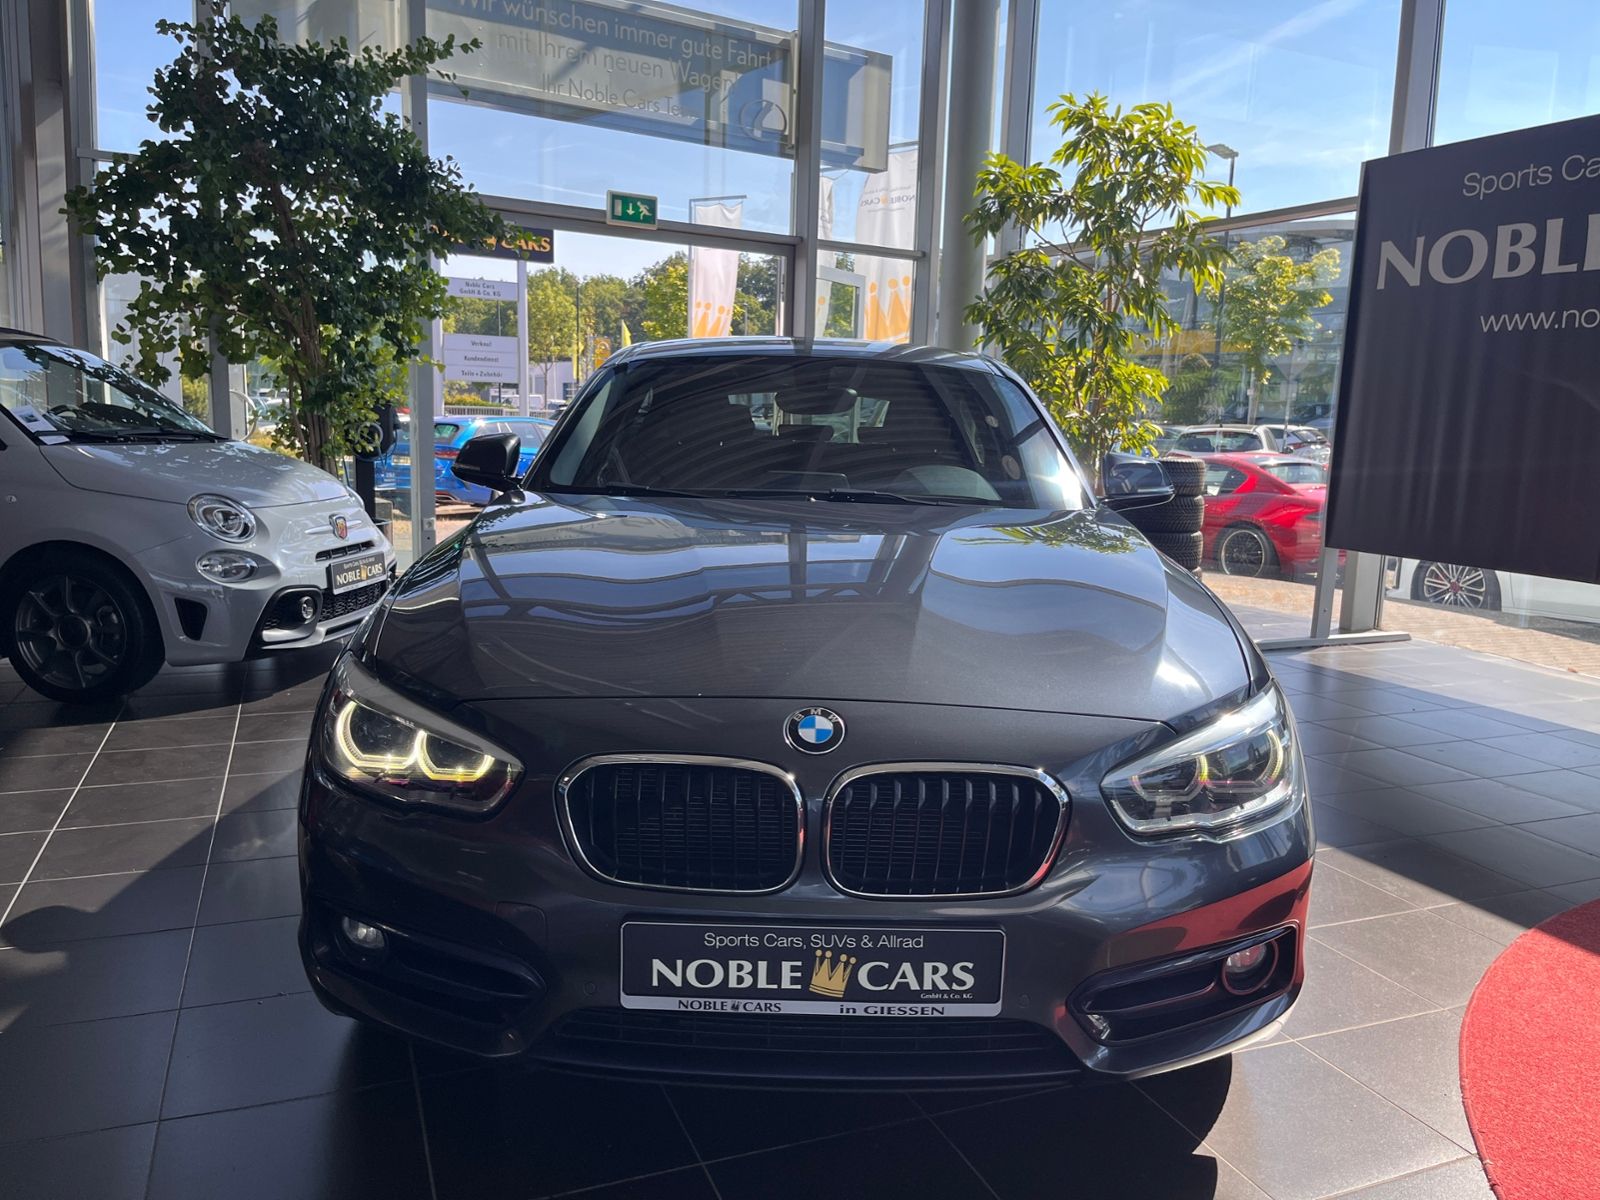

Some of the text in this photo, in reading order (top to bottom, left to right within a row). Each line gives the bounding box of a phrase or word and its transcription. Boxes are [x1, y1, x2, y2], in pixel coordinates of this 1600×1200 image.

[503, 0, 609, 36] wünschen
[615, 17, 677, 49] immer
[681, 38, 722, 61] gute
[496, 31, 530, 53] mit
[538, 32, 598, 66] Ihrem
[603, 53, 664, 80] neuen
[542, 73, 564, 94] Ihr
[568, 77, 618, 105] Noble
[623, 88, 660, 112] Cars
[1462, 162, 1553, 200] Sports
[1479, 307, 1600, 333] www.no
[337, 570, 361, 586] NOBLE
[367, 563, 383, 577] CARS
[792, 707, 839, 723] BMW
[704, 932, 924, 950] Sports Cars, SUVs & Allrad
[651, 958, 976, 992] NOBLE CARS
[677, 999, 782, 1013] NOBLE CARS
[839, 1004, 945, 1016] in GIESSEN
